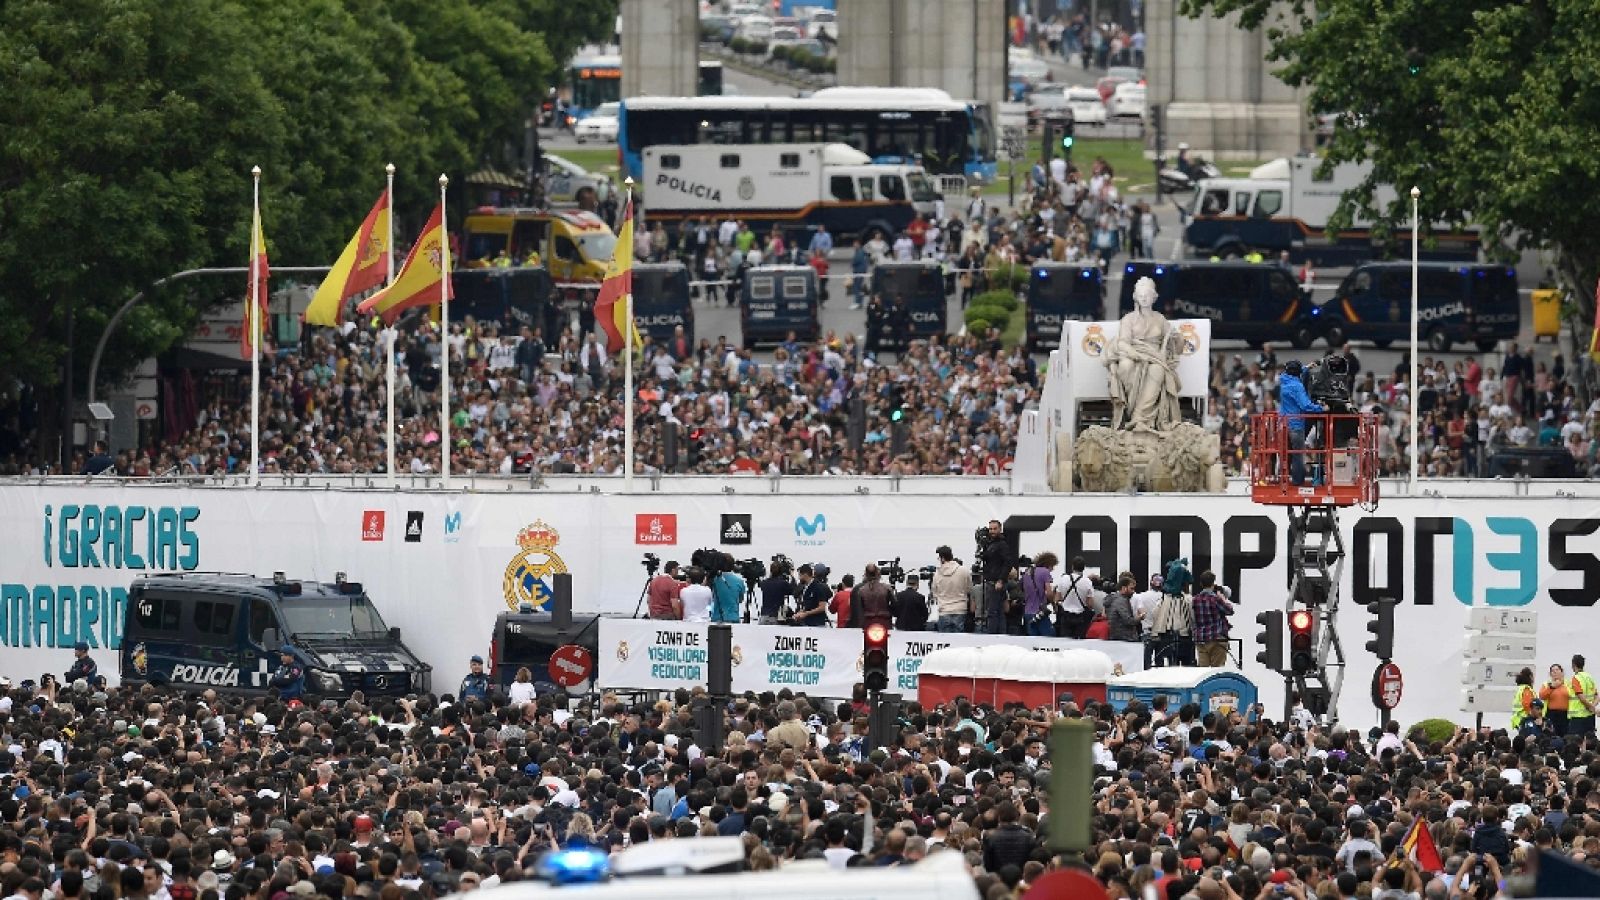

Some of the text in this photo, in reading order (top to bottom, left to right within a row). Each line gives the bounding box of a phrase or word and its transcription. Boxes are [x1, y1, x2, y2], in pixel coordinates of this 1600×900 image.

[656, 174, 723, 203] POLICIA
[655, 631, 699, 646] ZONA DE
[774, 635, 819, 652] ZONA DE
[648, 646, 706, 663] VISIBILIDAD
[766, 652, 826, 669] VISIBILIDAD
[652, 664, 701, 680] REDUCIDA
[768, 669, 820, 685] REDUCIDA
